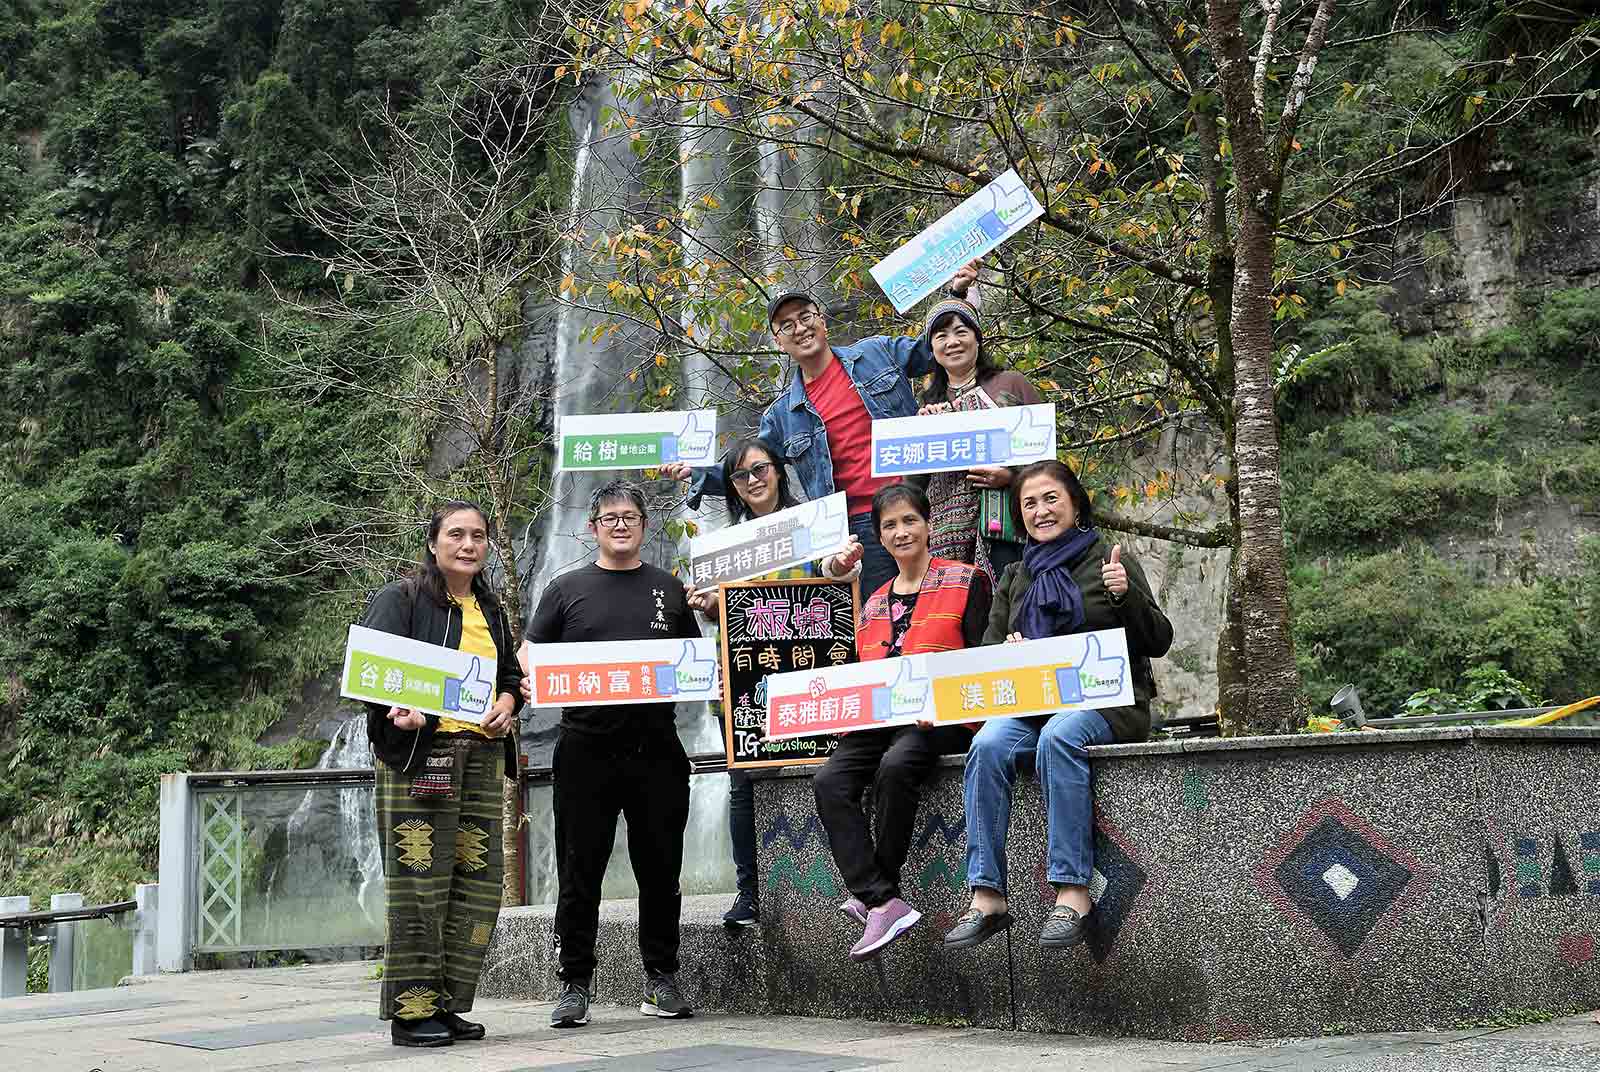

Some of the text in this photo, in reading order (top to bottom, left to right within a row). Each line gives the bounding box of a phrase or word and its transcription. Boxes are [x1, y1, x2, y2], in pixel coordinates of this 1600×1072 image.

[573, 440, 617, 462] 給樹
[879, 437, 971, 466] 安娜貝兒
[694, 536, 794, 584] 東昇特產店
[745, 597, 834, 638] 板娘
[732, 641, 850, 671] 有時間會
[547, 669, 631, 697] 加納富
[778, 694, 861, 727] 泰雅廚房
[734, 731, 761, 758] IG
